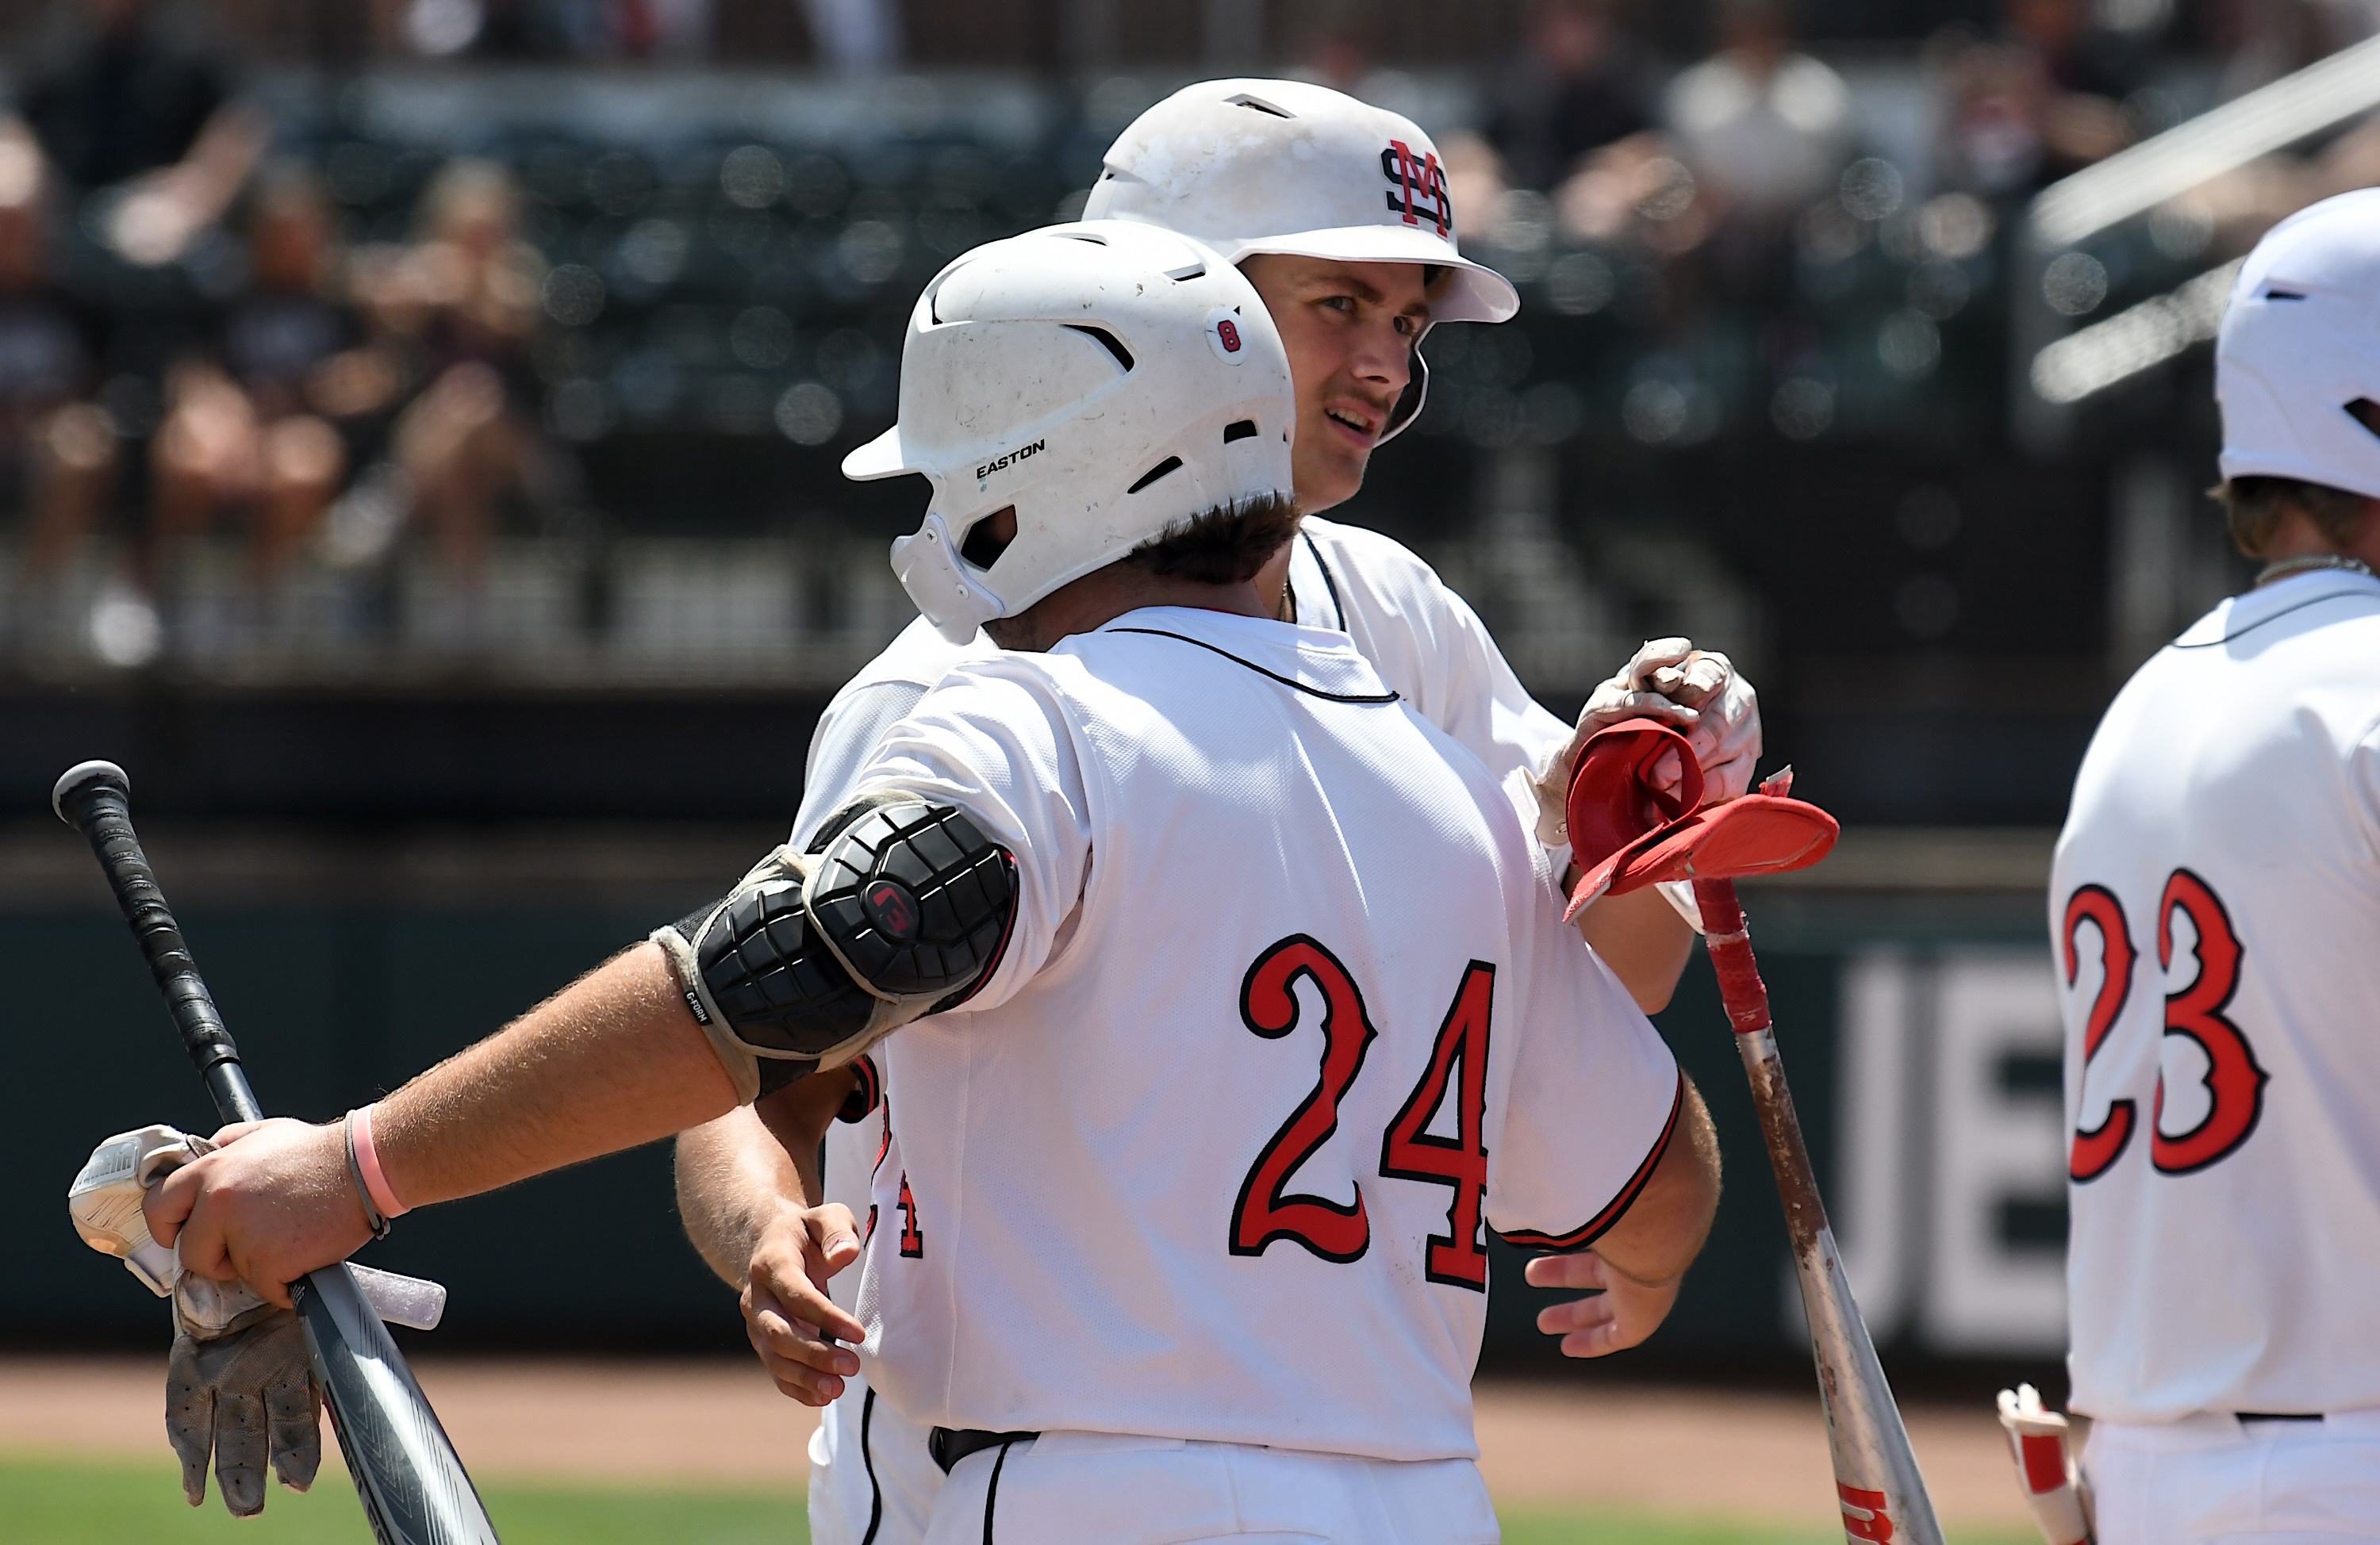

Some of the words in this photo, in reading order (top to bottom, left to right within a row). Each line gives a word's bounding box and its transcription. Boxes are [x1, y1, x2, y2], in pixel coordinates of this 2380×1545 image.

[1217, 320, 1242, 353] 8
[977, 439, 1045, 480] EASTON
[686, 992, 708, 1022] G-FORM
[2064, 867, 2271, 1185] 23
[1229, 933, 1496, 1294] 24
